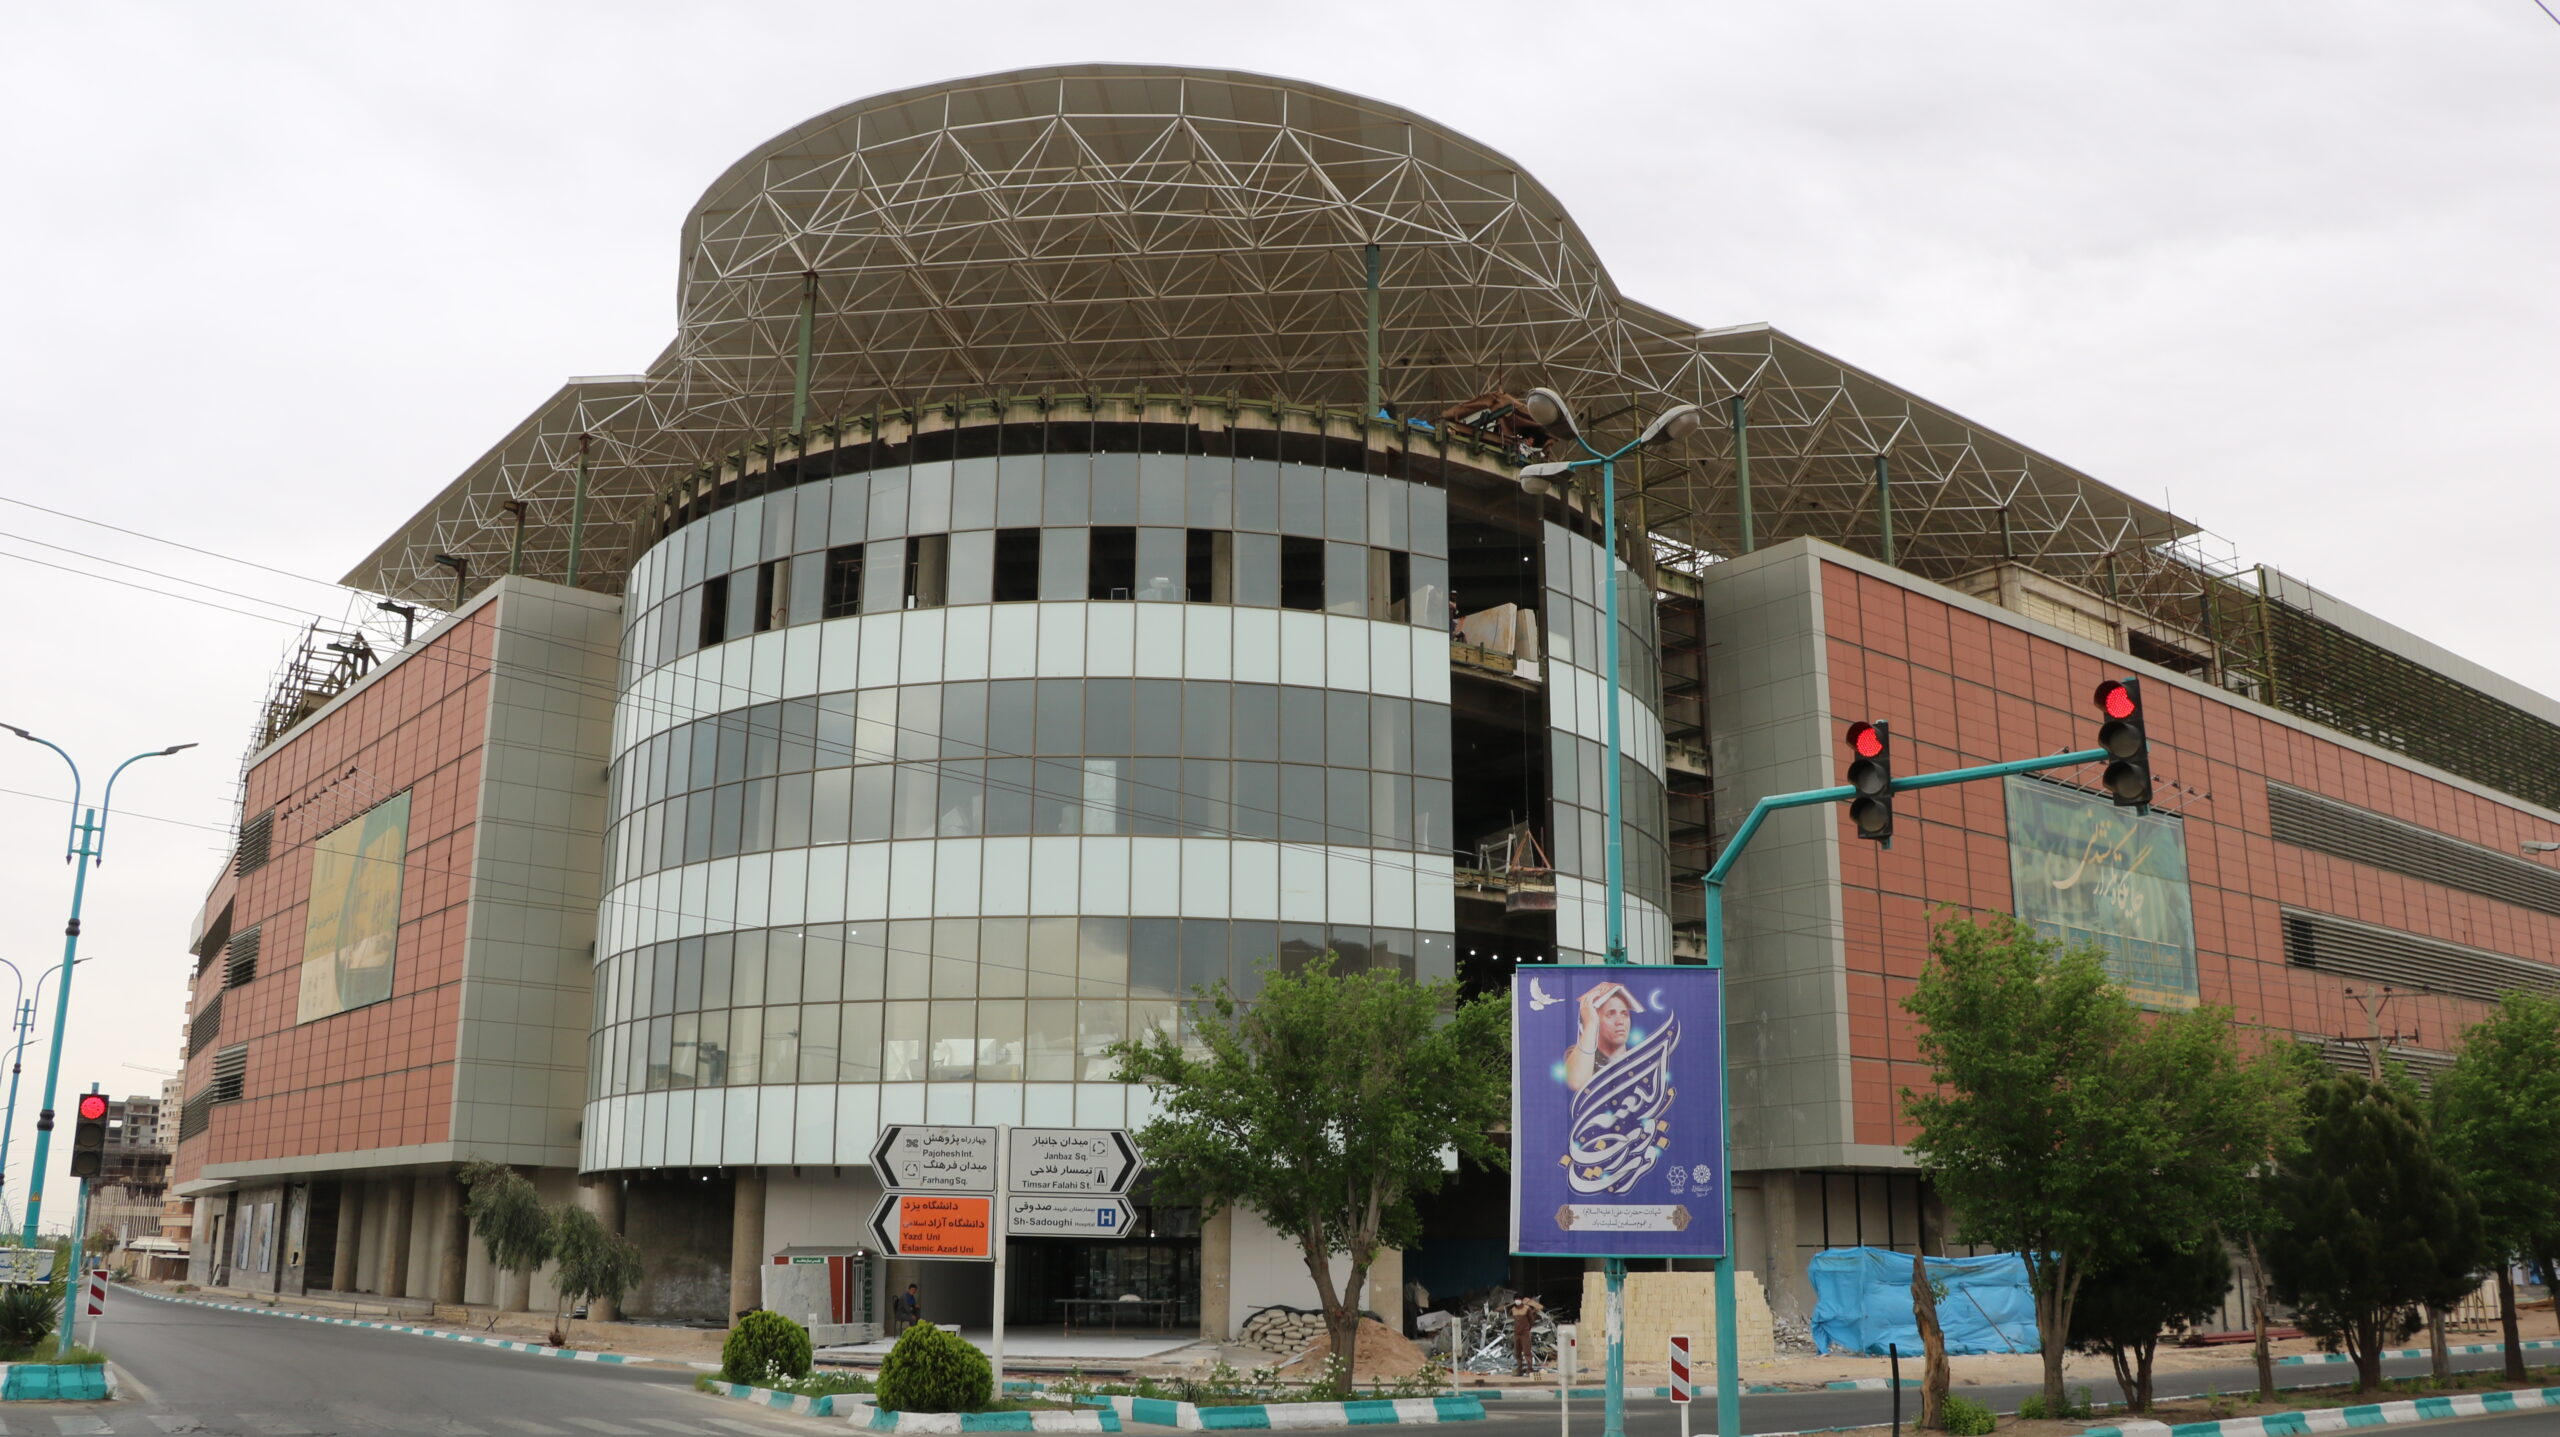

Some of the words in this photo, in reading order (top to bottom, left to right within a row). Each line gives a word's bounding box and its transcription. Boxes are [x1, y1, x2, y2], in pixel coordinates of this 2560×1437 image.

[923, 1133, 960, 1146] پژوهش
[1032, 1136, 1058, 1147] جانباز
[1060, 1136, 1089, 1148] میدان
[922, 1149, 960, 1159] Pajohesh
[1044, 1152, 1073, 1160] Janbaz
[923, 1160, 958, 1172] فرهنگ
[960, 1161, 988, 1172] میدان
[1030, 1165, 1058, 1176] فلاحی
[1060, 1165, 1093, 1177] تیمسار
[922, 1176, 955, 1186] Farhang
[1022, 1180, 1051, 1189] Timsar
[1052, 1181, 1078, 1189] Falahi
[904, 1201, 921, 1212] یزد
[922, 1200, 959, 1211] دانشگاه
[1014, 1201, 1052, 1213] صدوقی
[927, 1216, 947, 1230] آزاد
[948, 1218, 985, 1229] دانشگاه
[1013, 1216, 1073, 1228] Sh-Sadoughi
[903, 1232, 923, 1240] Yazd
[926, 1233, 941, 1241] Uni
[901, 1243, 934, 1252] Eslamic
[937, 1244, 958, 1253] Azad
[959, 1245, 974, 1253] Uni
